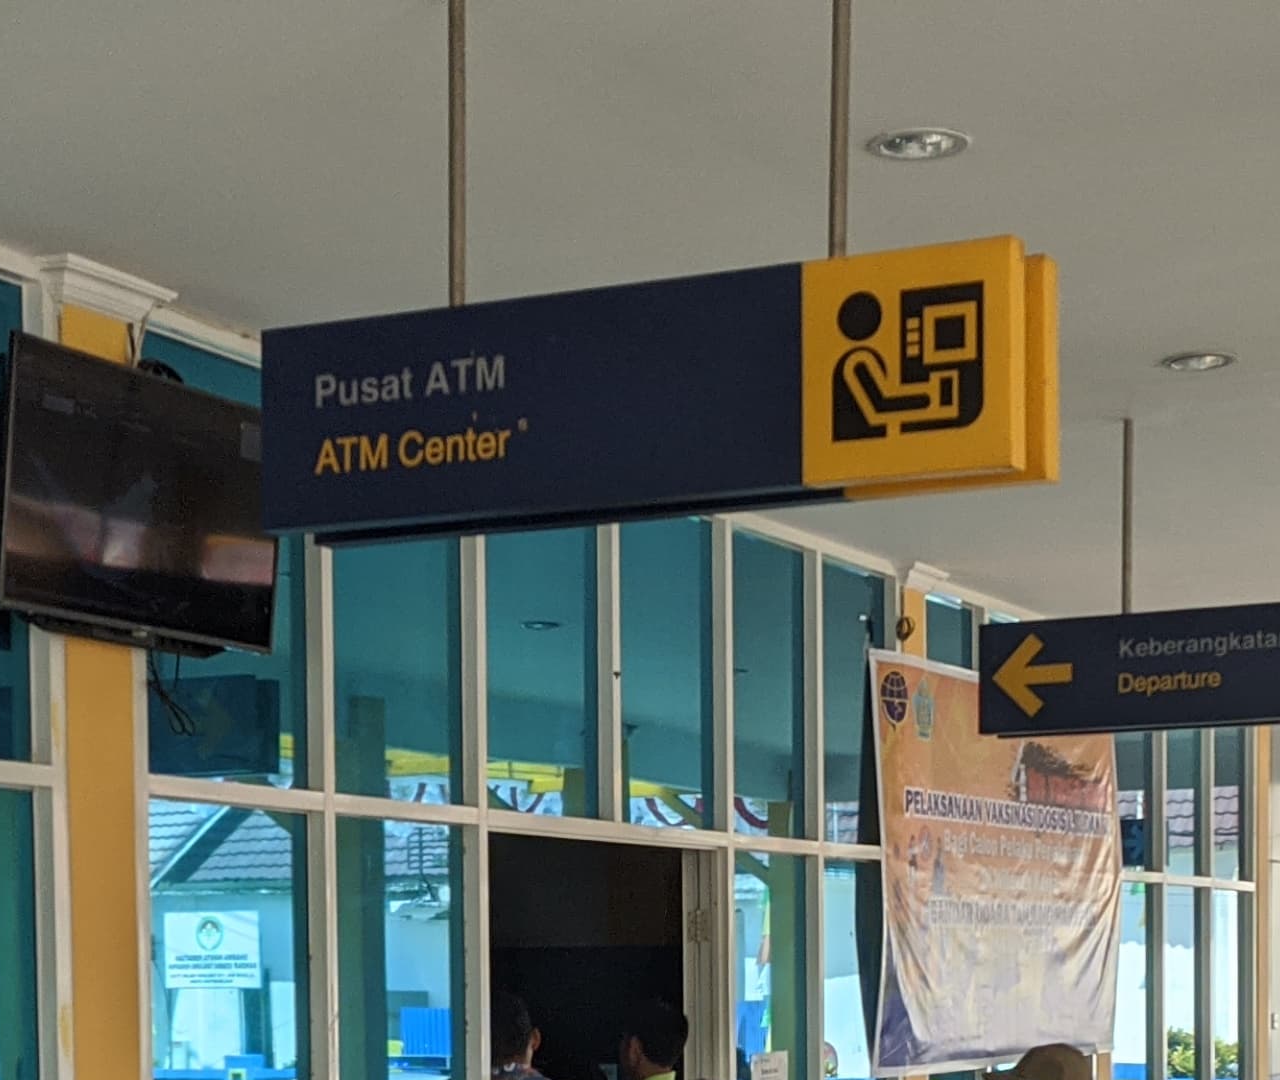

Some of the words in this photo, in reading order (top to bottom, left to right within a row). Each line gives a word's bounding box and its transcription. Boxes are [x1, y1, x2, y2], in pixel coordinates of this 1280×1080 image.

[315, 367, 413, 408] Pusat
[425, 355, 505, 396] ATM
[314, 433, 388, 476] ATM
[399, 427, 511, 468] Center
[1117, 670, 1222, 696] Departure
[905, 788, 983, 819] PELAKSANAAN
